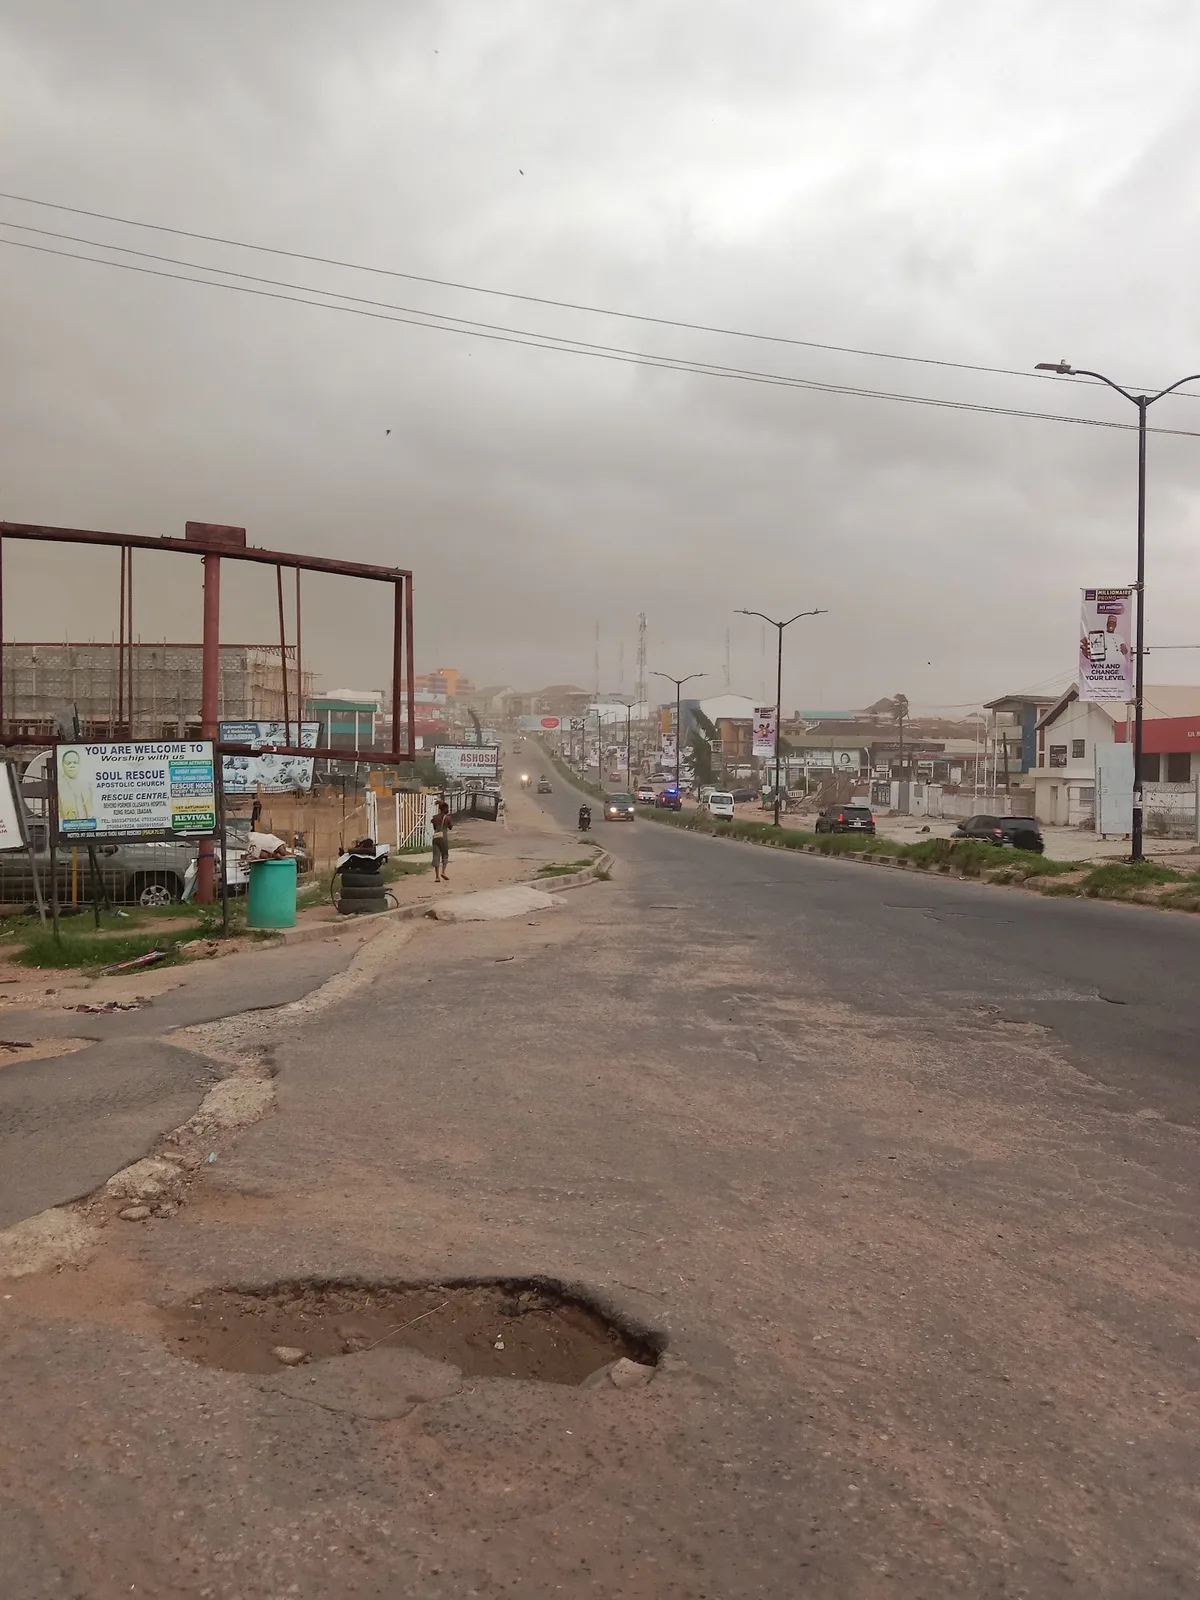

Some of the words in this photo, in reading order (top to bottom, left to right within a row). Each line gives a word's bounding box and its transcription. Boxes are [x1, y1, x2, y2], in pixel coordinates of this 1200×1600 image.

[85, 746, 107, 756] YOU
[110, 745, 132, 755] ARE
[134, 744, 187, 754] WELCOME
[189, 744, 204, 753] TO
[101, 754, 145, 763] Worship
[147, 753, 169, 761] with
[460, 753, 496, 762] ASHOSH
[95, 771, 122, 781] SOUL
[125, 770, 165, 780] RESCUE
[96, 781, 135, 789] APOSTOLIC
[101, 793, 134, 801] RESCUE
[135, 791, 170, 801] CENTRE,
